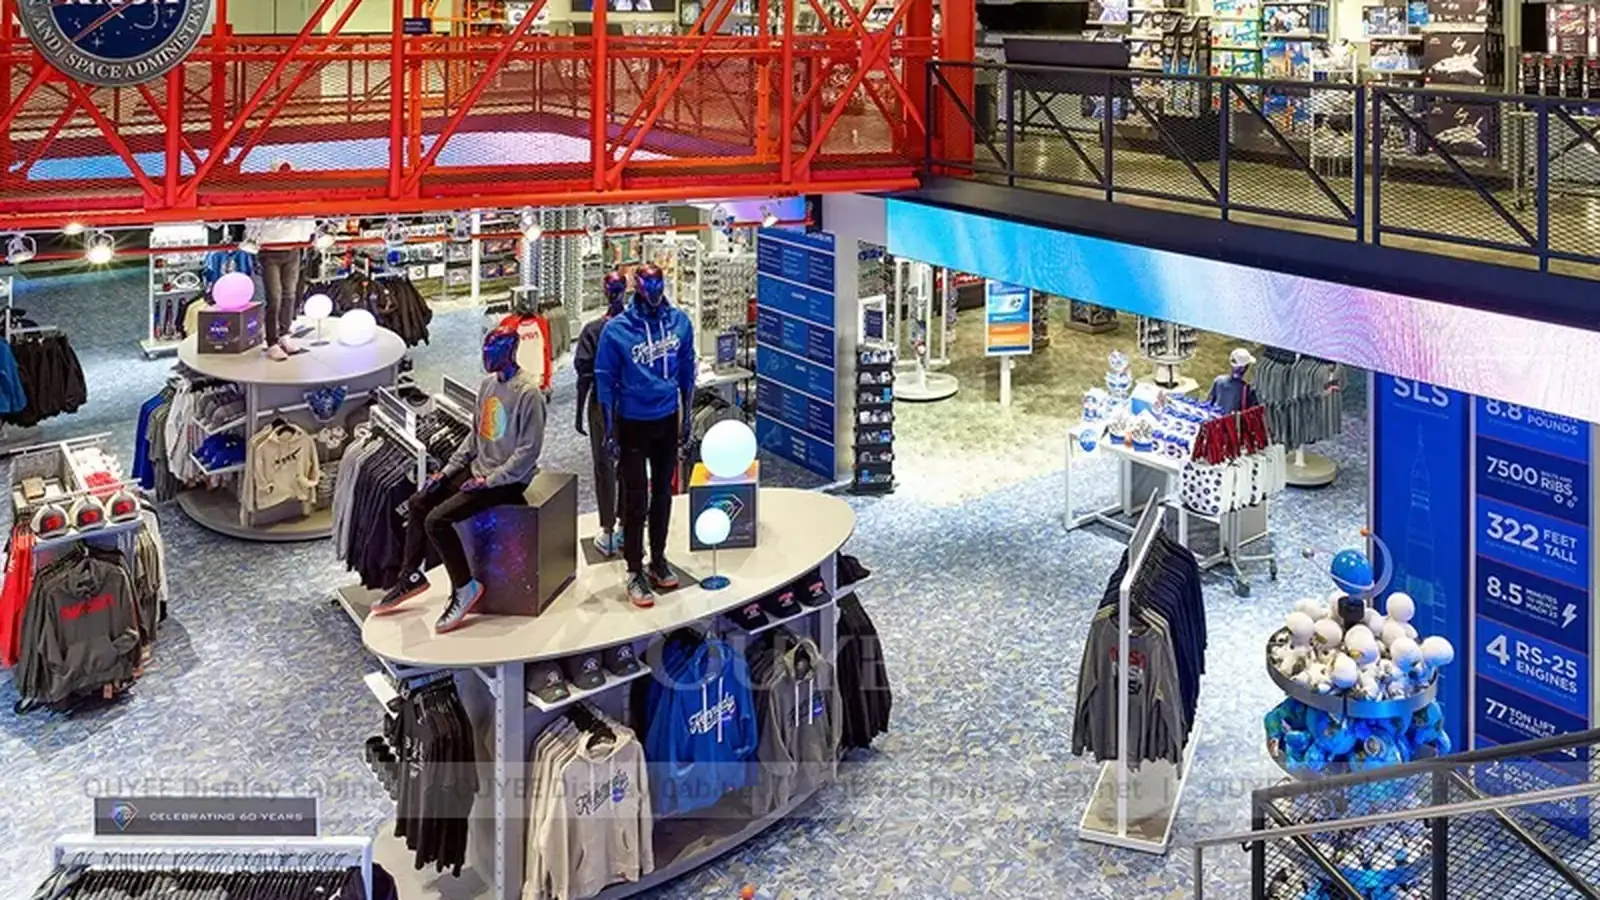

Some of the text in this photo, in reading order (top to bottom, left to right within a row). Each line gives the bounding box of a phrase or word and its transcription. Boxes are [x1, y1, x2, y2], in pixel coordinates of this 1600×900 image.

[66, 52, 122, 79] SPACE
[124, 0, 204, 78] ADMINISTRA
[1393, 376, 1449, 408] SLS
[1527, 413, 1579, 436] POUNDS
[1486, 455, 1539, 486] 7500
[1541, 476, 1574, 497] RIBS
[1486, 511, 1540, 552] 322
[1543, 529, 1578, 549] FEET
[1543, 542, 1579, 565] TALL
[1486, 575, 1523, 605] 8.5
[1485, 634, 1578, 679] 4 RS-25
[1516, 660, 1578, 694] ENGINES
[1485, 697, 1556, 734] 77 TON LIFT
[1508, 716, 1553, 738] CAPABILIT
[149, 811, 303, 821] CELEBRATING 60 YEARS
